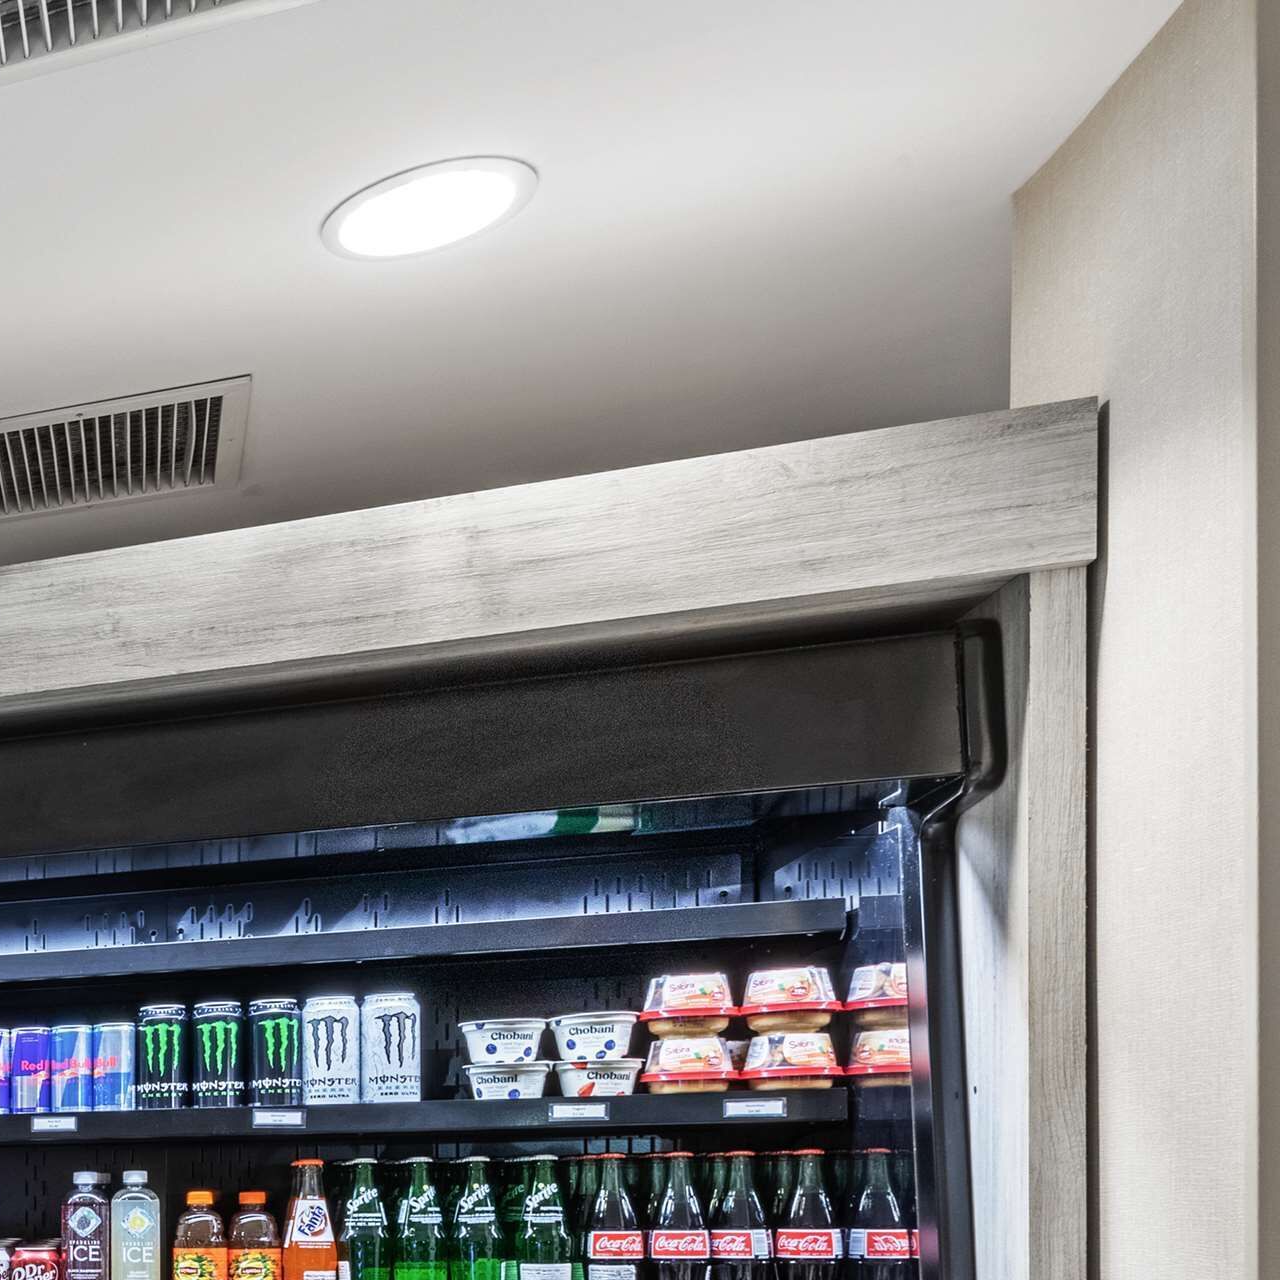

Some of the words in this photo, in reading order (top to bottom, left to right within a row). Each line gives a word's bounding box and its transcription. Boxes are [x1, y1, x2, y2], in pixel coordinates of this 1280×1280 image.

[491, 1031, 534, 1041] Chobani
[569, 1024, 615, 1036] Chobani
[252, 1077, 302, 1089] MONSTE
[476, 1074, 518, 1085] Chobani
[587, 1071, 631, 1081] Chobani
[346, 1187, 378, 1214] Sprite
[460, 1183, 490, 1213] Sprite
[526, 1182, 558, 1211] Sprite
[297, 1205, 325, 1236] Fanta
[654, 1235, 706, 1251] Coca-Cola
[777, 1234, 828, 1250] Coca-Cola
[69, 1246, 102, 1262] ICE
[122, 1247, 154, 1263] ICE
[26, 1263, 45, 1275] Dr
